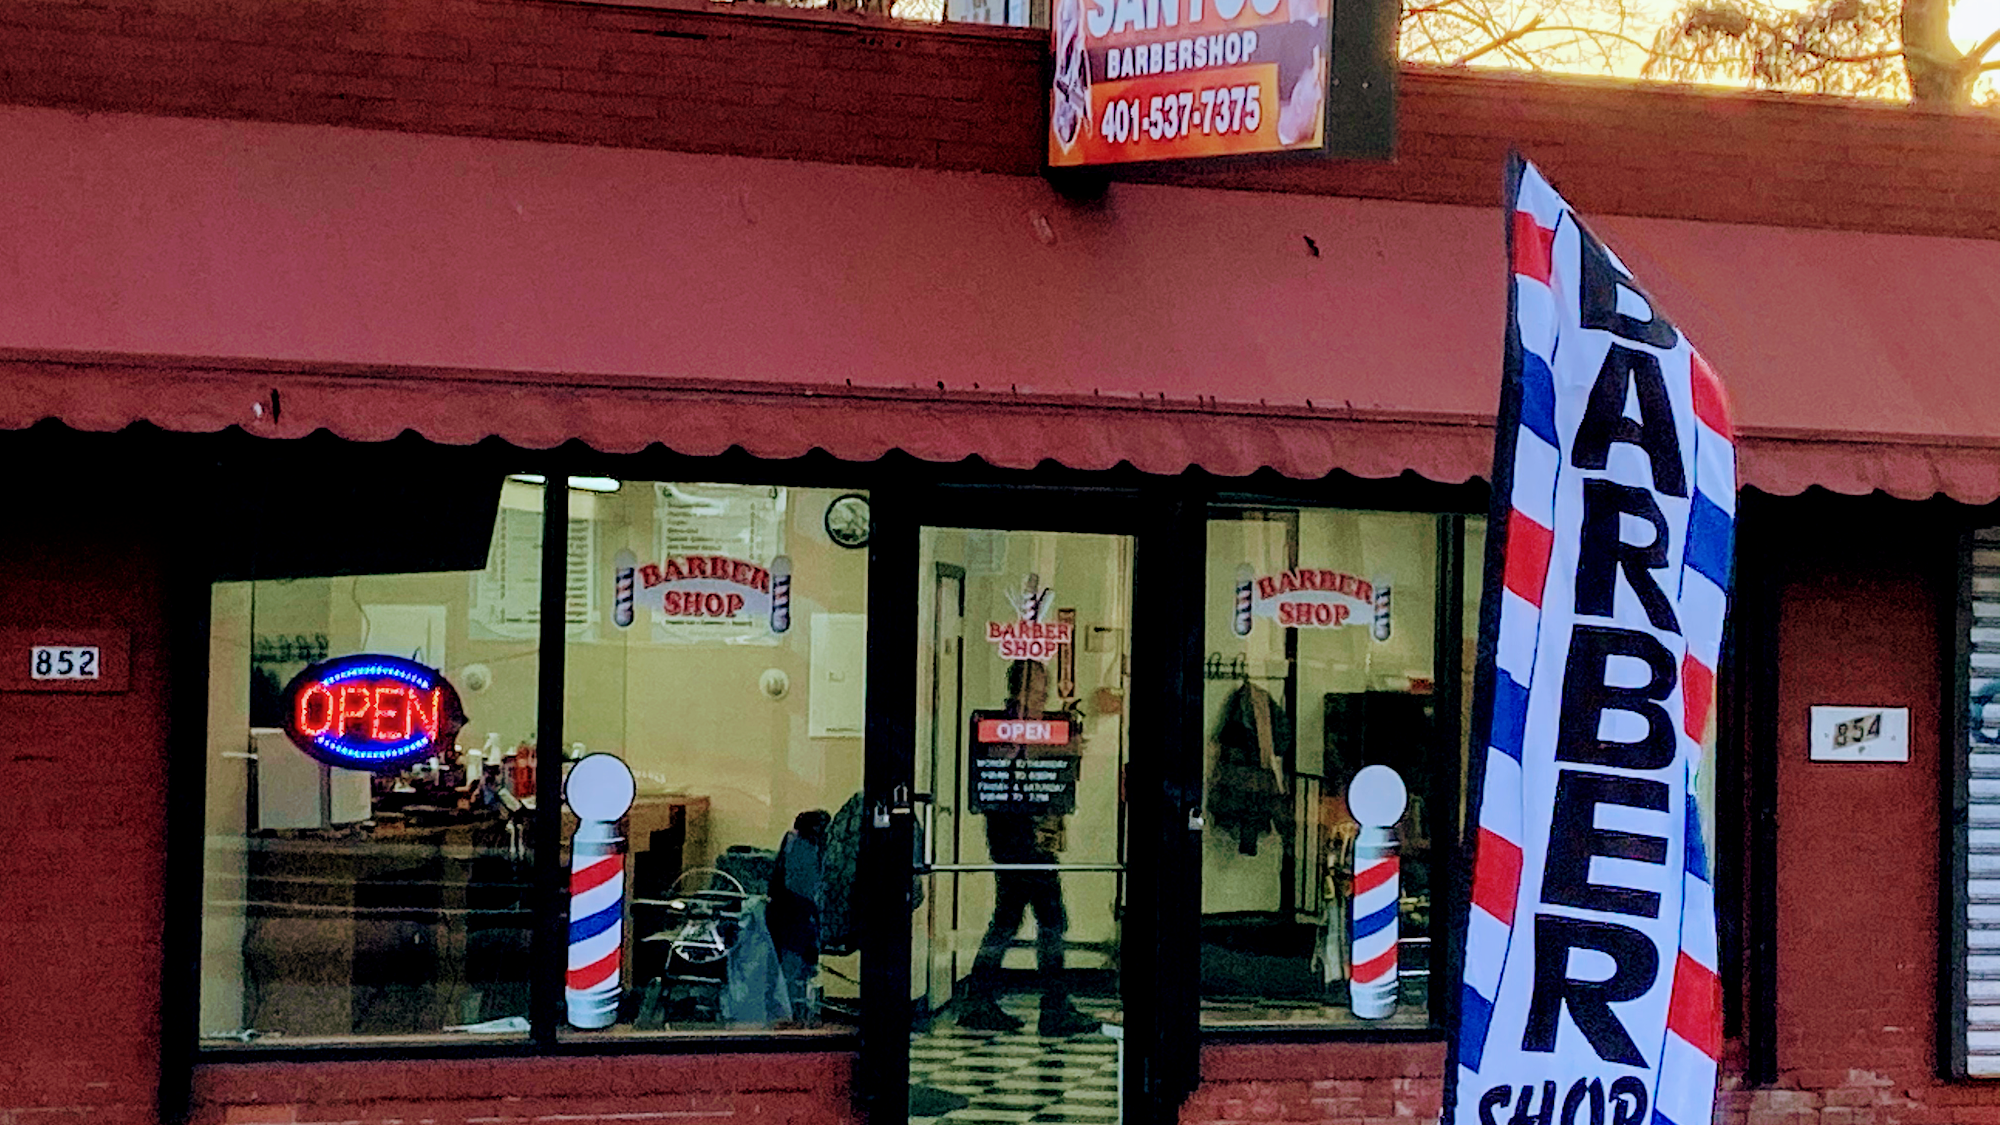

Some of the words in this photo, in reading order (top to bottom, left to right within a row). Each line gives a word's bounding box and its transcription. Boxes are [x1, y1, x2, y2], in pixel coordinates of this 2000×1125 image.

[1107, 31, 1257, 79] BARBERSHOP
[1101, 85, 1261, 143] 401-537-7375
[639, 554, 771, 594] BARBER
[1257, 569, 1374, 605] BARBER
[663, 590, 745, 618] SHOP
[1279, 602, 1351, 626] SHOP
[988, 620, 1069, 640] BARBER
[35, 649, 96, 676] 852
[1002, 641, 1057, 657] SHOP
[300, 685, 441, 741] OPEN
[996, 722, 1051, 741] OPEN
[1834, 713, 1883, 748] 854
